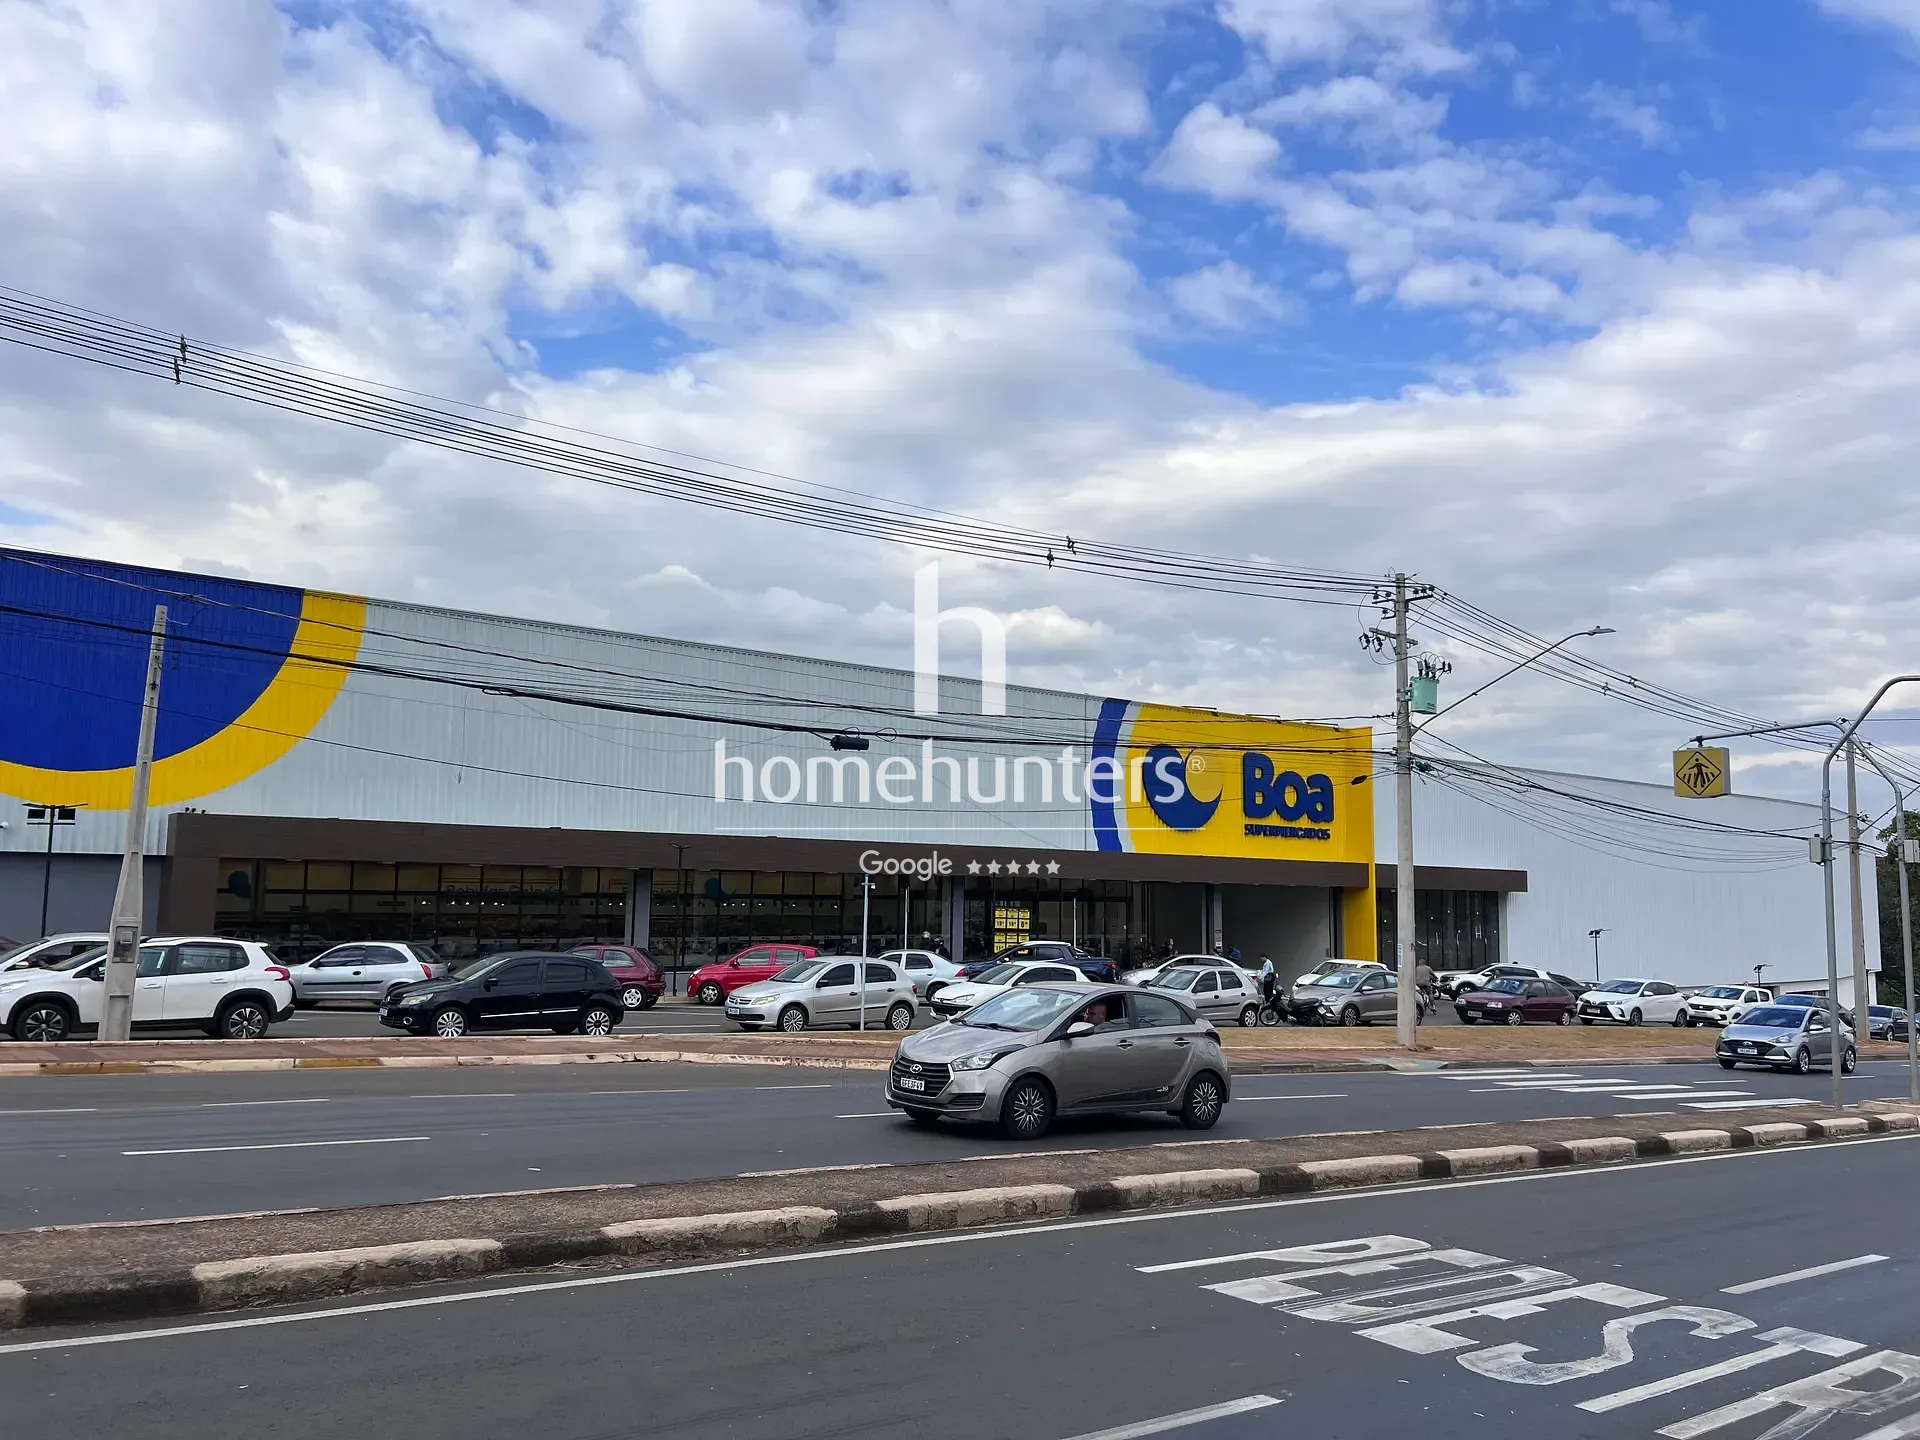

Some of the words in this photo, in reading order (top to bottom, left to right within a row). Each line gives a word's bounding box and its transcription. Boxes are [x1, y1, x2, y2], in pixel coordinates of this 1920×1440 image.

[1242, 751, 1335, 823] Boa
[1243, 823, 1331, 840] SUPERMERCADOS
[1134, 1234, 1920, 1440] PEDESTR
